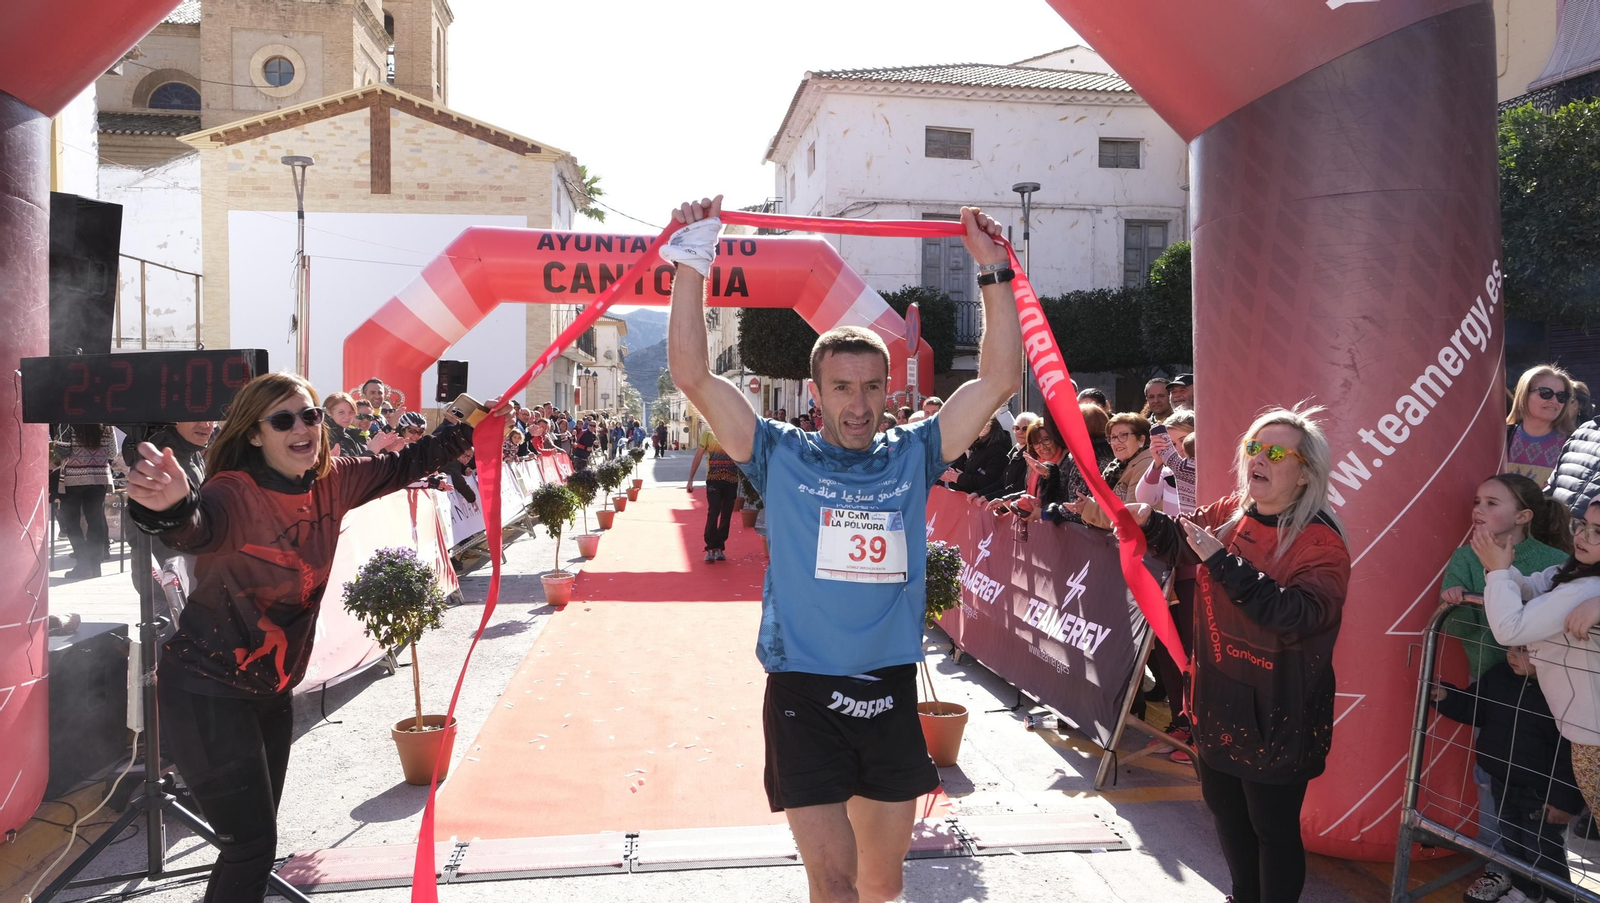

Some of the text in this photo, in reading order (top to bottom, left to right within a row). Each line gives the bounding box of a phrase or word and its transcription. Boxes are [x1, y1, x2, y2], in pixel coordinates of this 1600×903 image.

[537, 233, 757, 257] AYUNTATO
[543, 261, 749, 297] CANTOIA
[1327, 259, 1502, 513] ww.teamergy.es
[835, 510, 870, 520] IV CxM
[844, 520, 885, 531] PÓLVORA
[848, 534, 887, 563] 39
[1022, 597, 1112, 655] TEAMERGY
[1226, 643, 1274, 670] Cantoria
